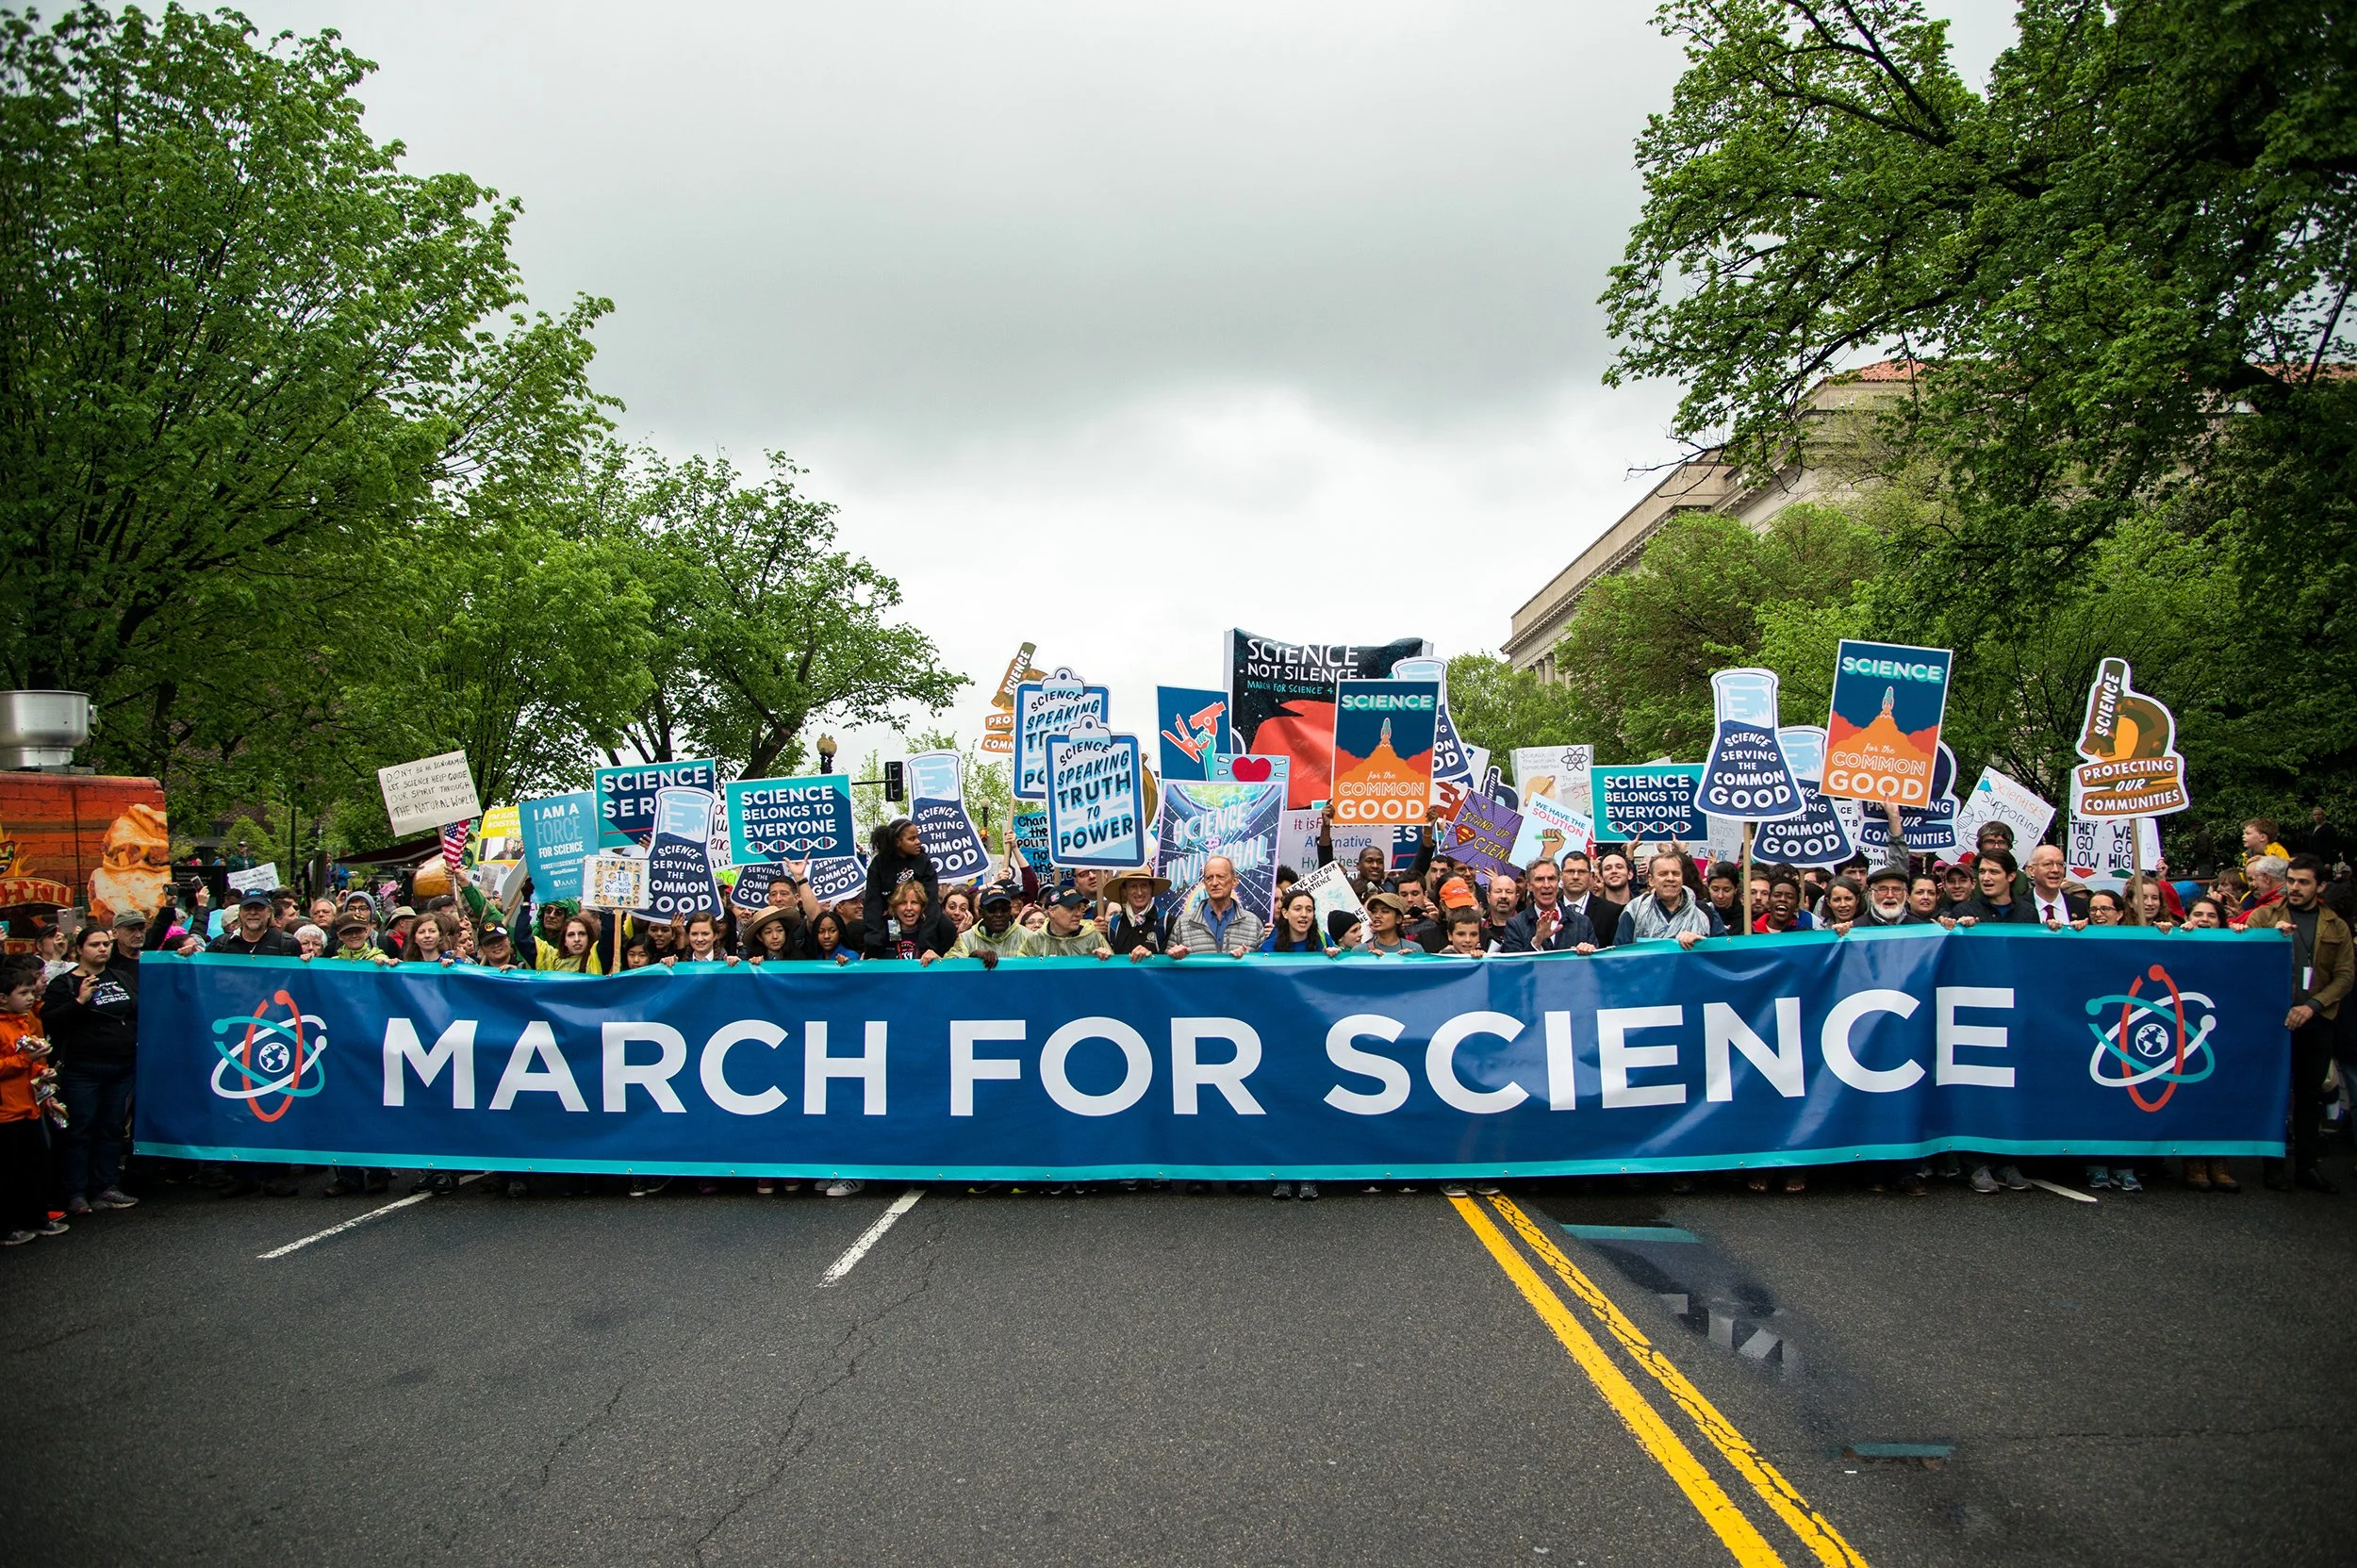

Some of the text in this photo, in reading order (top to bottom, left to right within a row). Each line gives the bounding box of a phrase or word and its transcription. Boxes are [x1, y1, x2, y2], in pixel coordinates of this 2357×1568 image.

[1004, 649, 1031, 696] SCIENCE
[1247, 663, 1359, 684] NOT SILENCE
[1841, 656, 1944, 683] SCIENCE
[1246, 680, 1271, 690] MARCH
[1273, 683, 1287, 693] FOR
[1289, 684, 1324, 695] SCIENCE
[1030, 690, 1083, 712] SCIENCE
[1342, 694, 1434, 710] SCIENCE
[2094, 671, 2120, 737] SCIENCE
[1026, 700, 1100, 730] SPEAKING
[1724, 732, 1772, 748] SCIENCE
[1863, 743, 1896, 754] for the
[1060, 741, 1113, 767] SCIENCE
[1721, 750, 1777, 763] SERVING
[1057, 751, 1129, 786] SPEAKING
[1738, 762, 1757, 770] THE
[1831, 751, 1926, 777] COMMON
[2083, 760, 2174, 781] PROTECTING
[387, 770, 468, 792] LET SCIENCE HELP GUIDE
[601, 766, 708, 793] SCIENCE
[1367, 771, 1381, 781] for
[1603, 774, 1689, 789] SCIENCE
[1713, 770, 1786, 786] COMMON
[1827, 769, 1924, 801] GOOD
[2115, 778, 2146, 792] OUR
[390, 793, 408, 804] OUR
[411, 786, 436, 799] SPIRIT
[740, 784, 834, 806] SCIENCE
[1058, 771, 1131, 811] TRUTH
[1339, 782, 1425, 796] COMMON
[1605, 791, 1689, 802] BELONGS TO
[1708, 785, 1791, 809] GOOD
[1992, 773, 2046, 821] Scientists
[394, 794, 476, 818] THE NATURAL WORLD
[602, 797, 655, 819] SER
[1337, 800, 1425, 819] GOOD
[2085, 789, 2180, 812] COMMUNITIES
[534, 802, 580, 820] I AM A
[741, 803, 834, 821] BELONGS TO
[917, 806, 959, 820] SCIENCE
[1087, 805, 1100, 820] TO
[1535, 801, 1586, 829] WE HAVE THE
[1606, 805, 1691, 818] EVERYONE
[1982, 791, 2039, 840] Supporting
[536, 816, 583, 846] FORCE
[743, 818, 837, 839] EVERYONE
[916, 821, 964, 834] SERVING
[1018, 816, 1047, 827] Chan
[1173, 802, 1251, 849] SCIENCE
[1294, 818, 1302, 830] It
[1306, 817, 1314, 830] is
[1461, 812, 1510, 837] STAND UP
[1532, 807, 1585, 838] SOLUTION
[1766, 819, 1836, 836] COMMON
[2069, 821, 2098, 836] THEY
[931, 832, 947, 840] THE
[1030, 827, 1047, 837] the
[1061, 817, 1134, 853] POWER
[2113, 825, 2131, 840] WE
[538, 841, 585, 858] FOR SCIENCE
[658, 845, 702, 860] SCIENCE
[921, 835, 972, 854] OMMON
[1762, 834, 1840, 857] GOOD
[2076, 836, 2093, 850] GO
[652, 860, 705, 873] SERVING
[930, 849, 979, 873] OOD
[2069, 850, 2100, 868] LOW
[748, 866, 782, 876] SERVING
[813, 863, 854, 884] COMMON
[1308, 869, 1325, 883] LOST
[1324, 863, 1337, 875] OUR
[650, 879, 709, 893] OMMON
[742, 879, 769, 890] COMM
[812, 870, 859, 896] GOOD
[1305, 875, 1331, 893] PATIENCE
[381, 986, 2016, 1116] MARCH FOR SCIENCE
